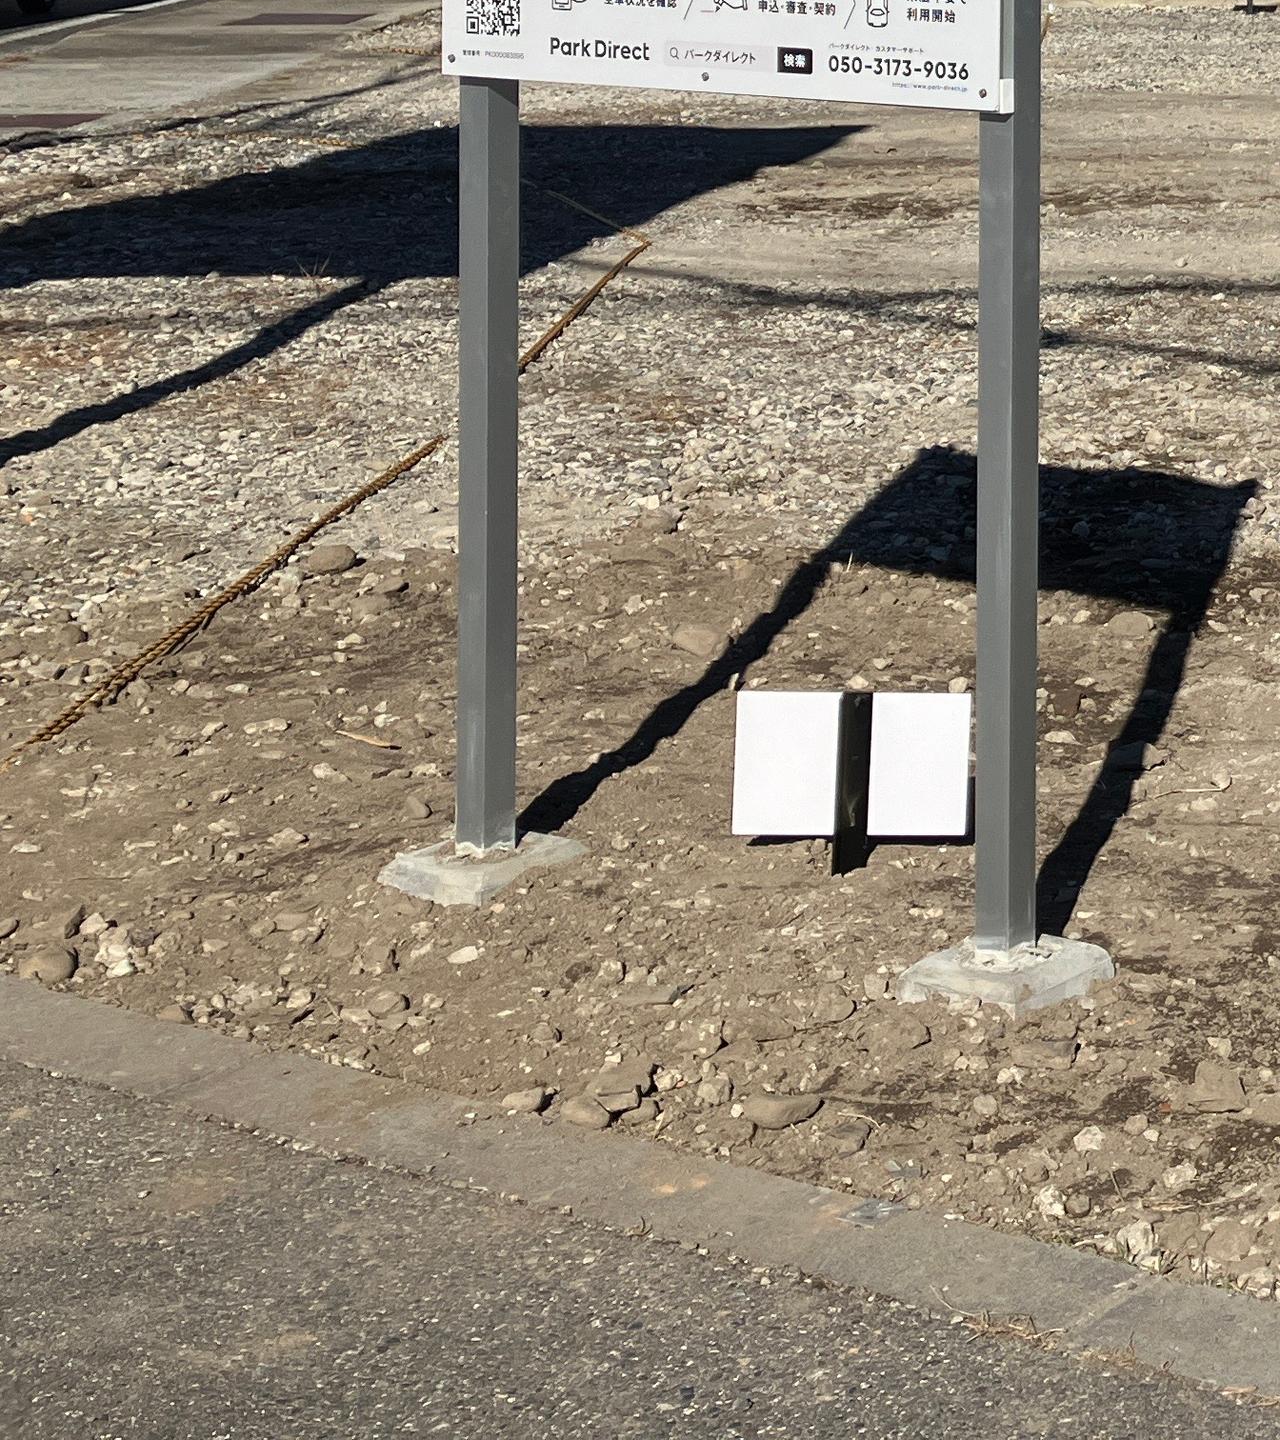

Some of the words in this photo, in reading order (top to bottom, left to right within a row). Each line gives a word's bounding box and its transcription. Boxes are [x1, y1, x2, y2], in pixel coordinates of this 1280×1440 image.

[906, 7, 956, 24] 利用開始
[549, 37, 591, 58] Park
[594, 39, 651, 61] Direct
[783, 53, 806, 68] 検索
[828, 54, 969, 81] 050-3173-9036
